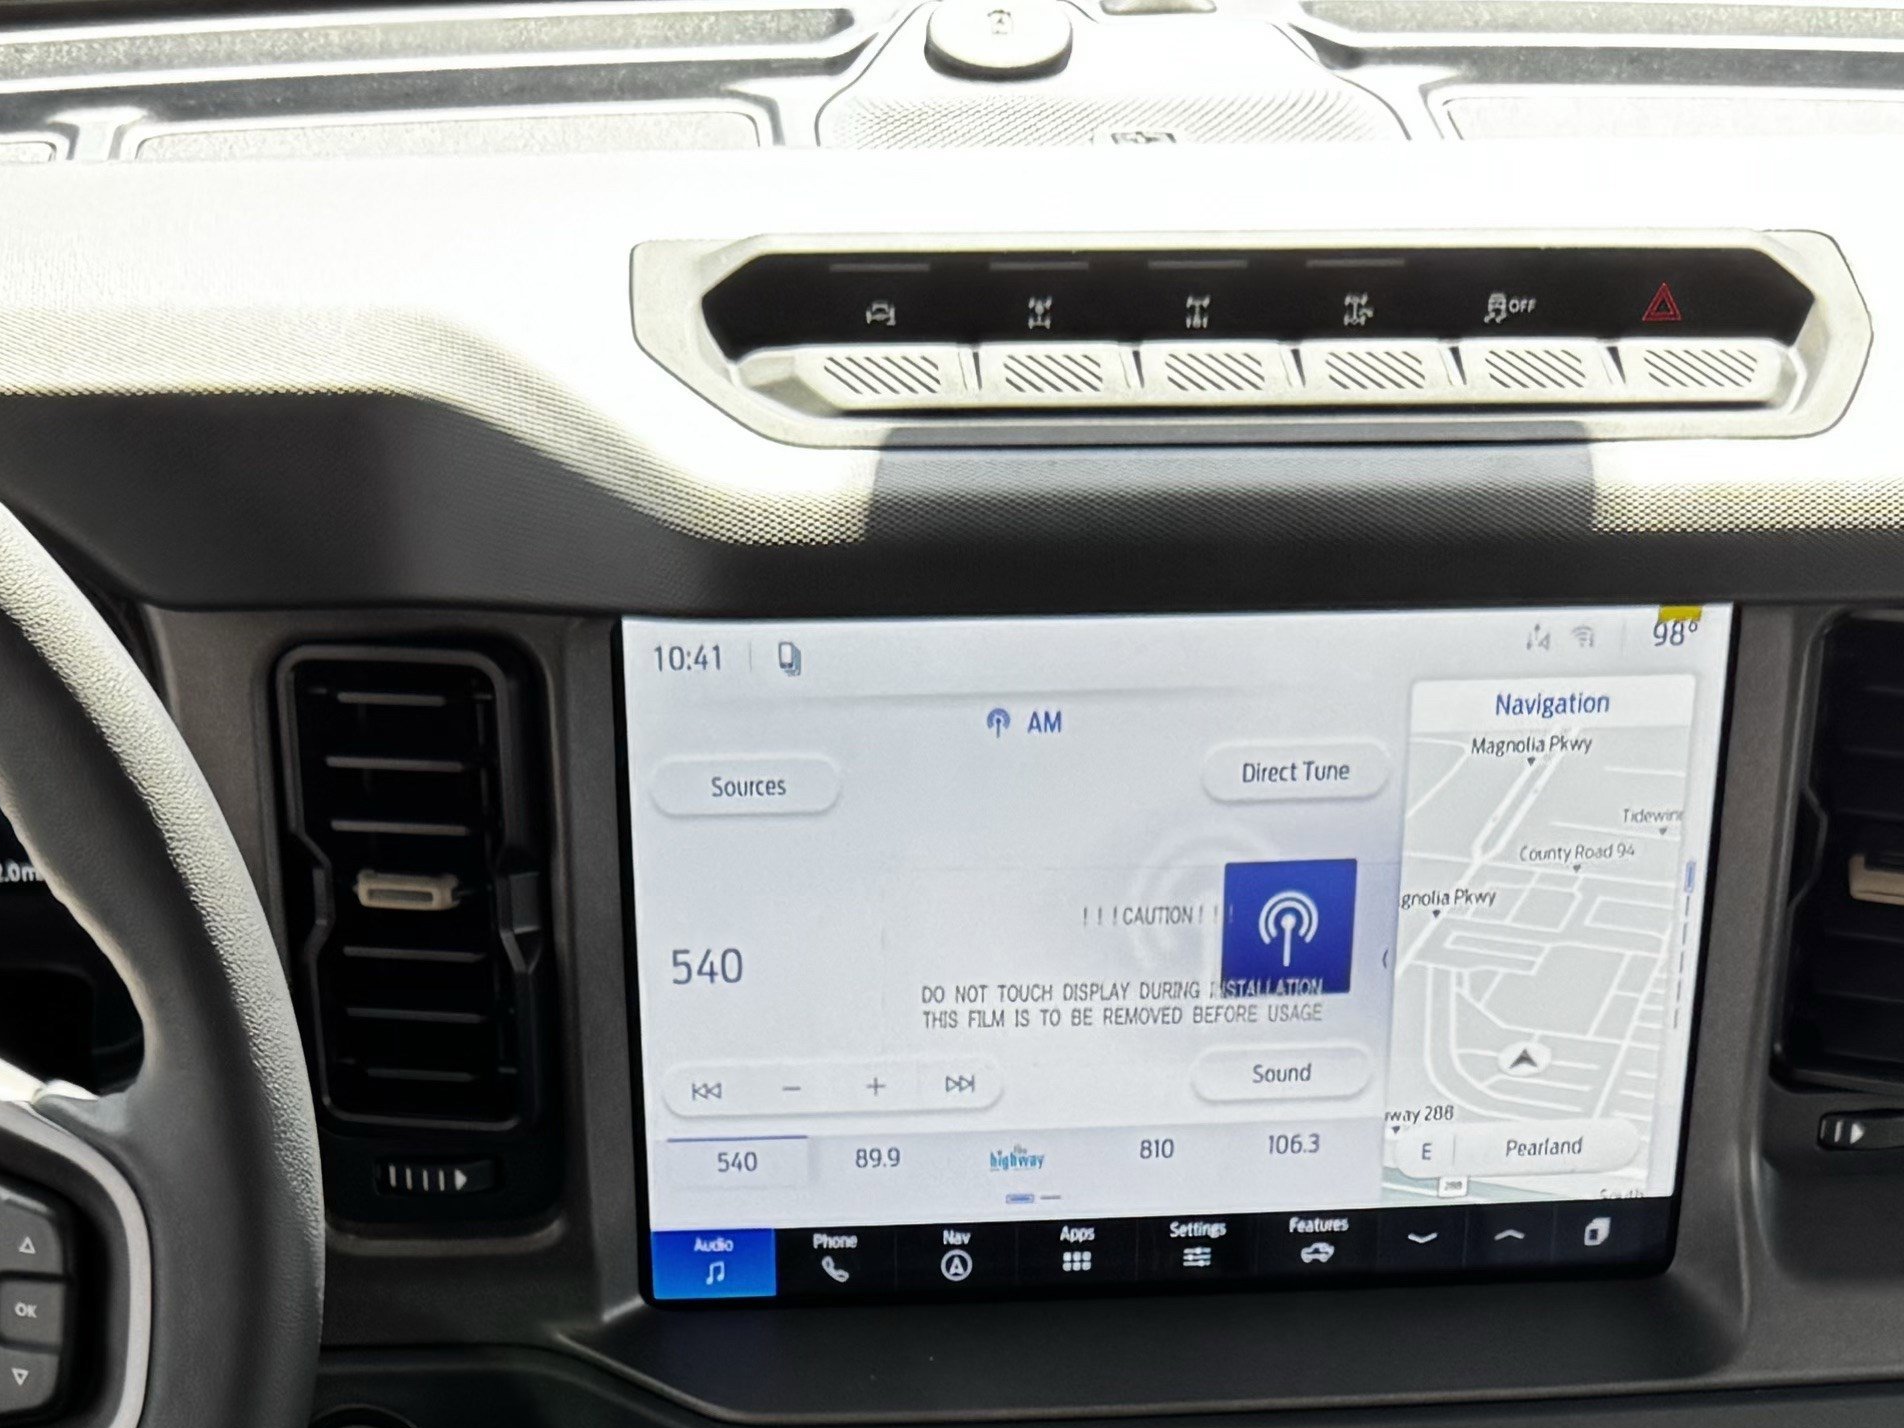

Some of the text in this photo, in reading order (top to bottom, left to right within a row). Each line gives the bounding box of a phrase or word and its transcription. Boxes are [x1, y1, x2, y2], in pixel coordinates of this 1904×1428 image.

[1509, 298, 1536, 313] OFF
[653, 644, 723, 673] 10:41
[1496, 693, 1610, 718] Navigation
[1027, 711, 1063, 734] AM
[1471, 735, 1593, 757] Magnolia Pkwy
[1241, 759, 1351, 784] Direct Tune
[711, 776, 787, 799] Sources
[1520, 844, 1635, 862] County Road 94
[1455, 890, 1496, 907] Pkwy
[1123, 906, 1193, 925] CAUTION
[671, 948, 744, 985] 540
[921, 985, 945, 1003] DO
[955, 985, 989, 1003] NOT
[996, 984, 1052, 1002] TOUCH
[1063, 982, 1130, 1001] DISPLAY
[1139, 981, 1200, 1000] DURING
[923, 1002, 1323, 1029] THIS FILM IS TO BE REMOVED BEFORE USAGE
[1252, 1062, 1312, 1086] Sound
[1140, 1139, 1174, 1159] 810
[1268, 1134, 1320, 1155] 106.3
[1421, 1143, 1432, 1160] E
[1506, 1136, 1584, 1158] Pearland
[717, 1152, 758, 1172] 540
[855, 1148, 900, 1168] 89.9
[1060, 1225, 1095, 1243] Apps
[1169, 1221, 1227, 1239] Settings
[1289, 1217, 1349, 1234] Features
[694, 1237, 734, 1253] Audio
[813, 1233, 858, 1250] Phone
[943, 1229, 971, 1246] Nav
[15, 1303, 37, 1318] OK
